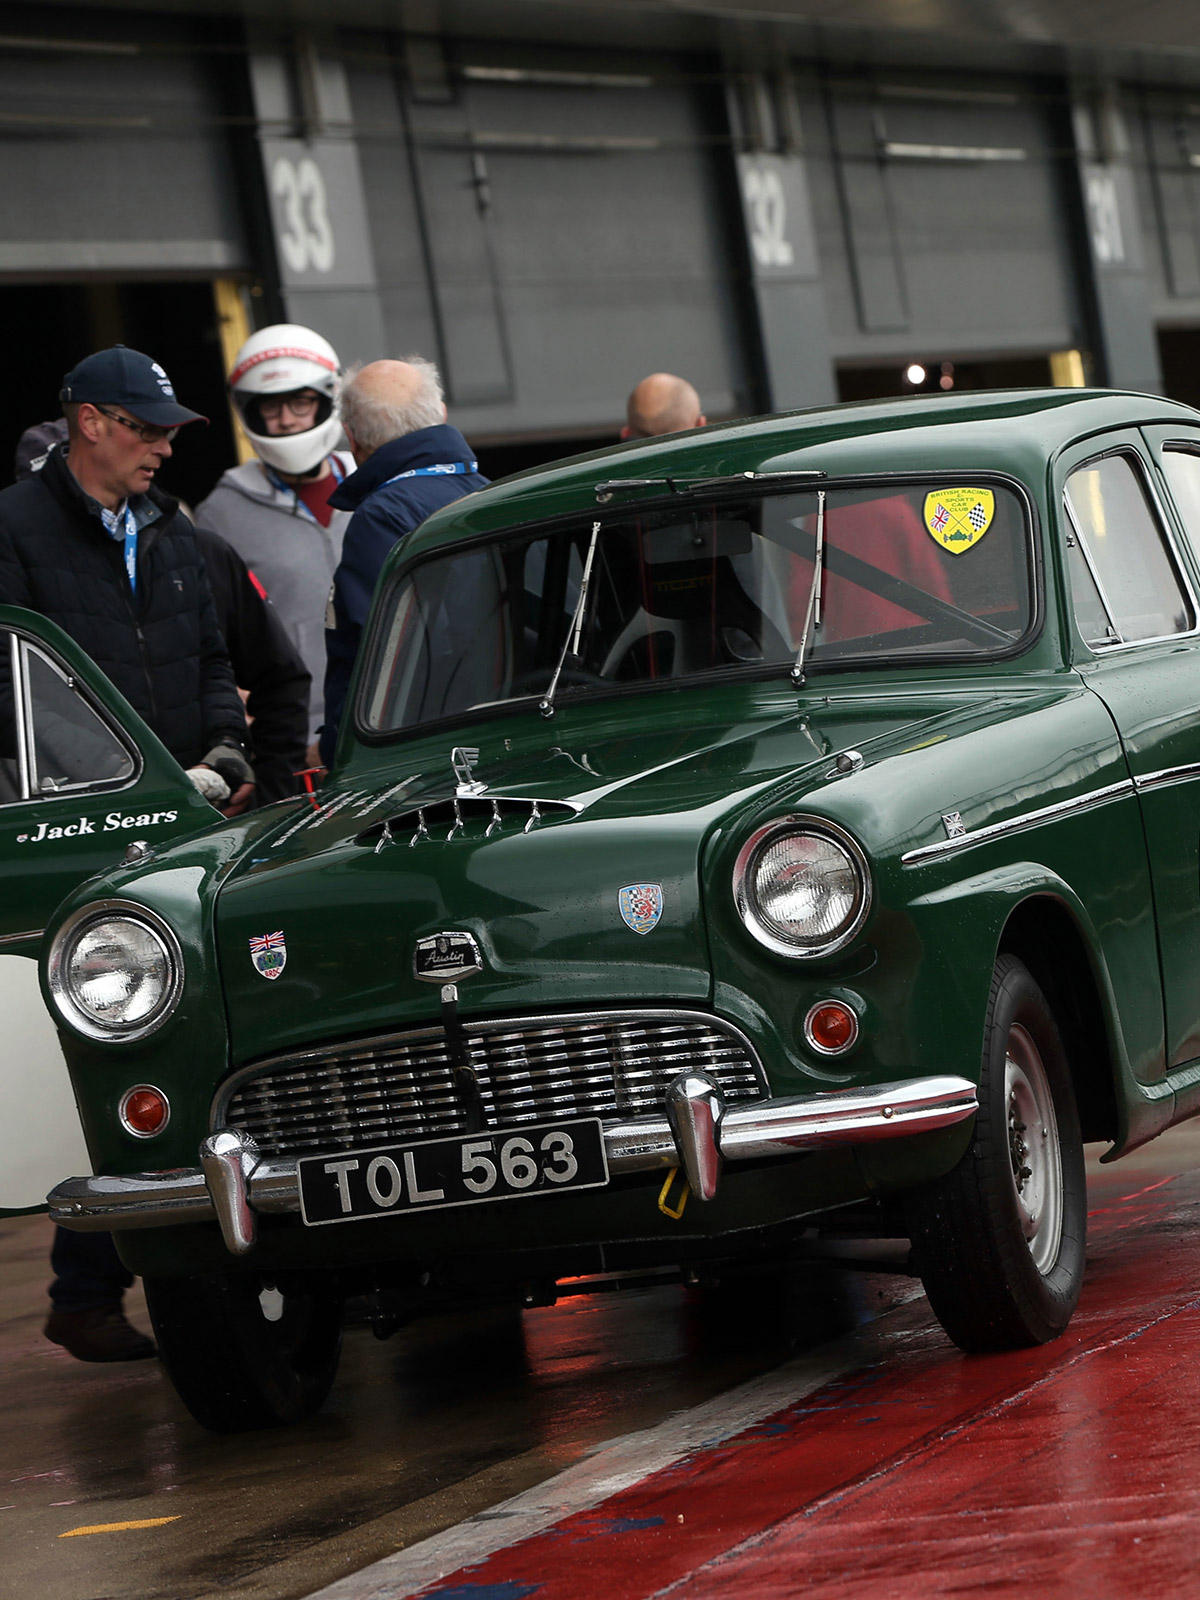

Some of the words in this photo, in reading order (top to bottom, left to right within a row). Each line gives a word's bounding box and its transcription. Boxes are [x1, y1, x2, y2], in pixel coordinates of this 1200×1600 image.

[271, 157, 335, 274] 33
[744, 169, 795, 267] 32
[930, 490, 960, 498] BRITISH
[30, 817, 96, 842] Jack
[102, 810, 178, 832] Sears
[424, 950, 464, 967] Austin
[324, 1151, 445, 1213] TOL
[461, 1131, 578, 1193] 563
